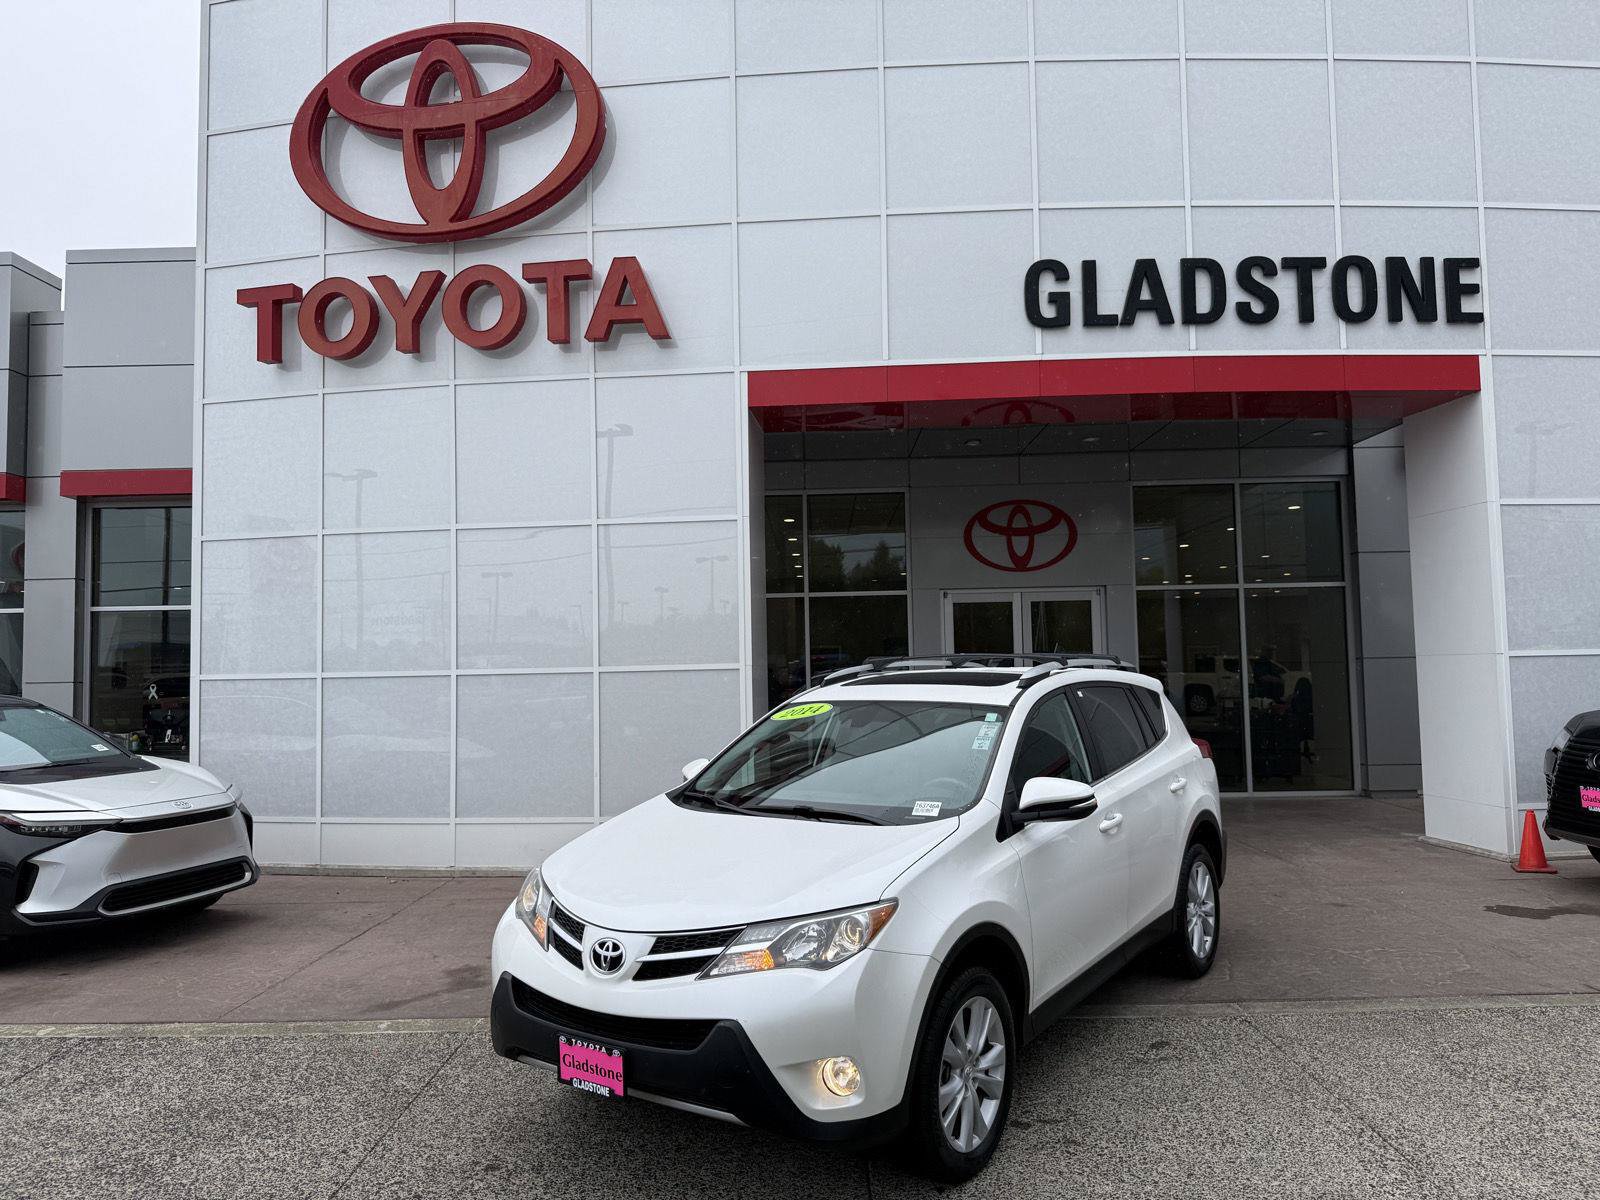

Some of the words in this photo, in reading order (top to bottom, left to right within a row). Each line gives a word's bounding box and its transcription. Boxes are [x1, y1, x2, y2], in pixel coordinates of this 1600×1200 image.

[1024, 255, 1484, 328] GLADSTONE
[237, 256, 672, 364] TOYOTA
[779, 704, 824, 718] 2014
[571, 1038, 607, 1053] TOYOTA
[562, 1053, 623, 1082] Gladstone
[572, 1078, 609, 1097] GLADSTONE
